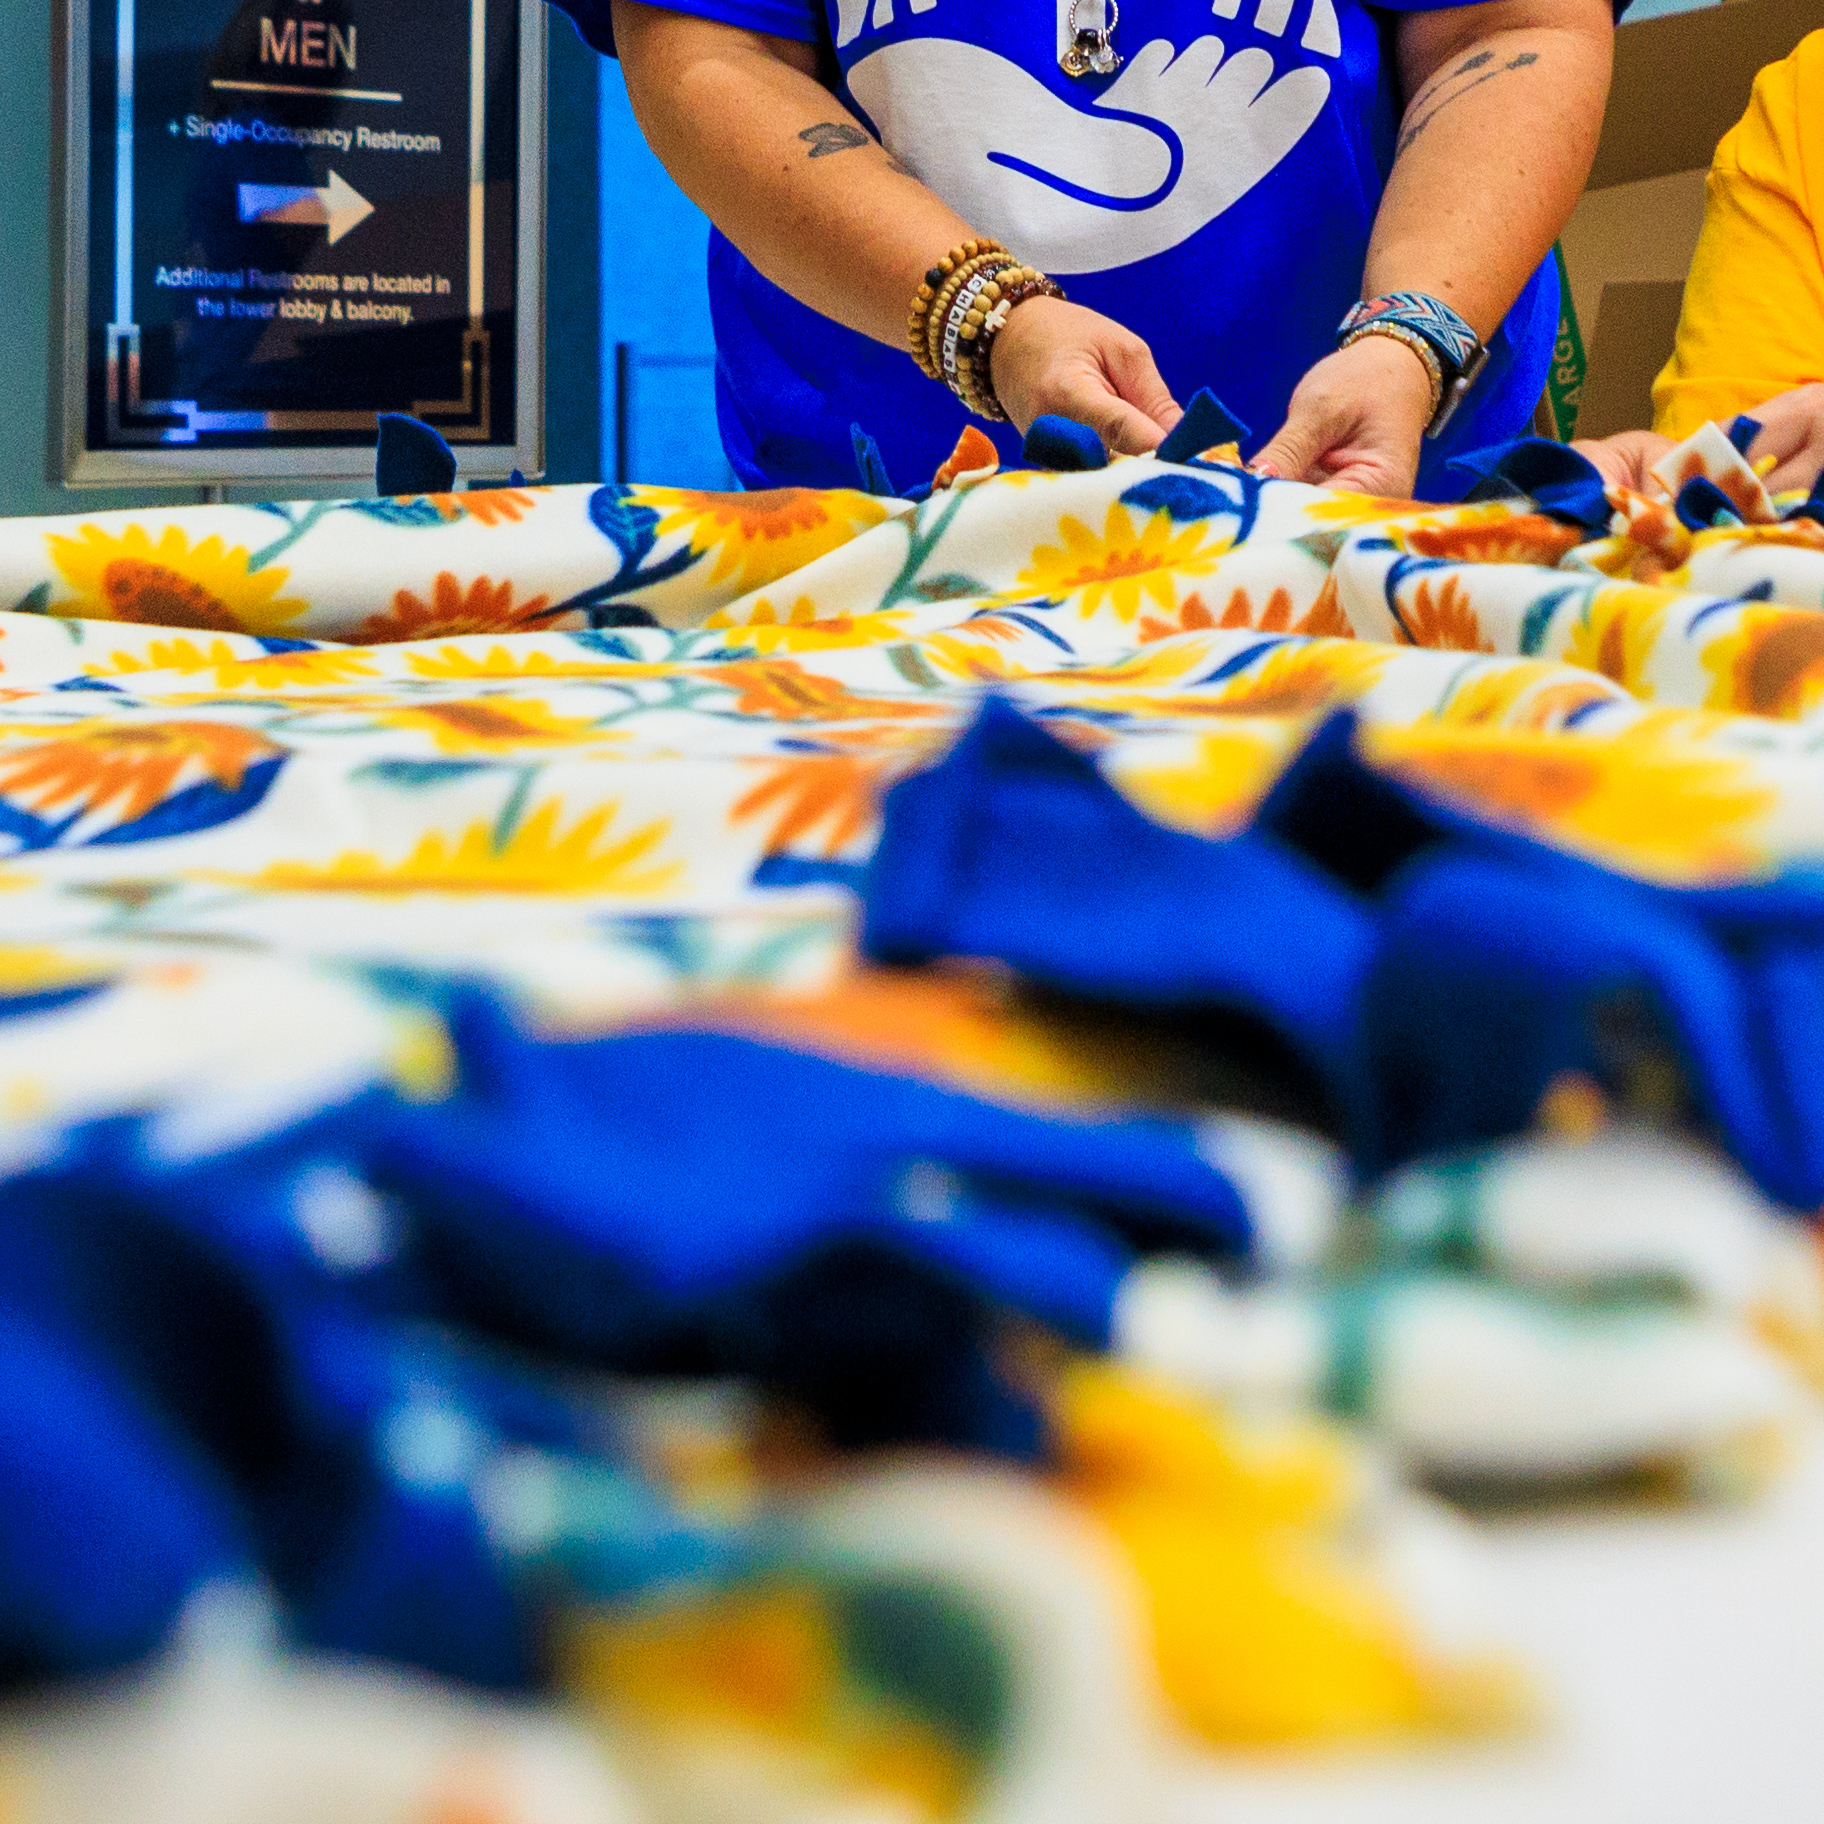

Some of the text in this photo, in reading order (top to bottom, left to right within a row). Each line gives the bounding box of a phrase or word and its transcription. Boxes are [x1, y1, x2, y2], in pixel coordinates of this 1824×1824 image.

[259, 16, 358, 70] MEN
[186, 113, 352, 152] Single-Occupancy
[355, 126, 441, 153] Restroom
[155, 264, 451, 294] Additional Restrooms are located in
[195, 296, 225, 318] the
[230, 297, 275, 319] lower
[279, 297, 327, 324] lobby
[330, 298, 344, 320] &
[1553, 317, 1583, 428] ARG
